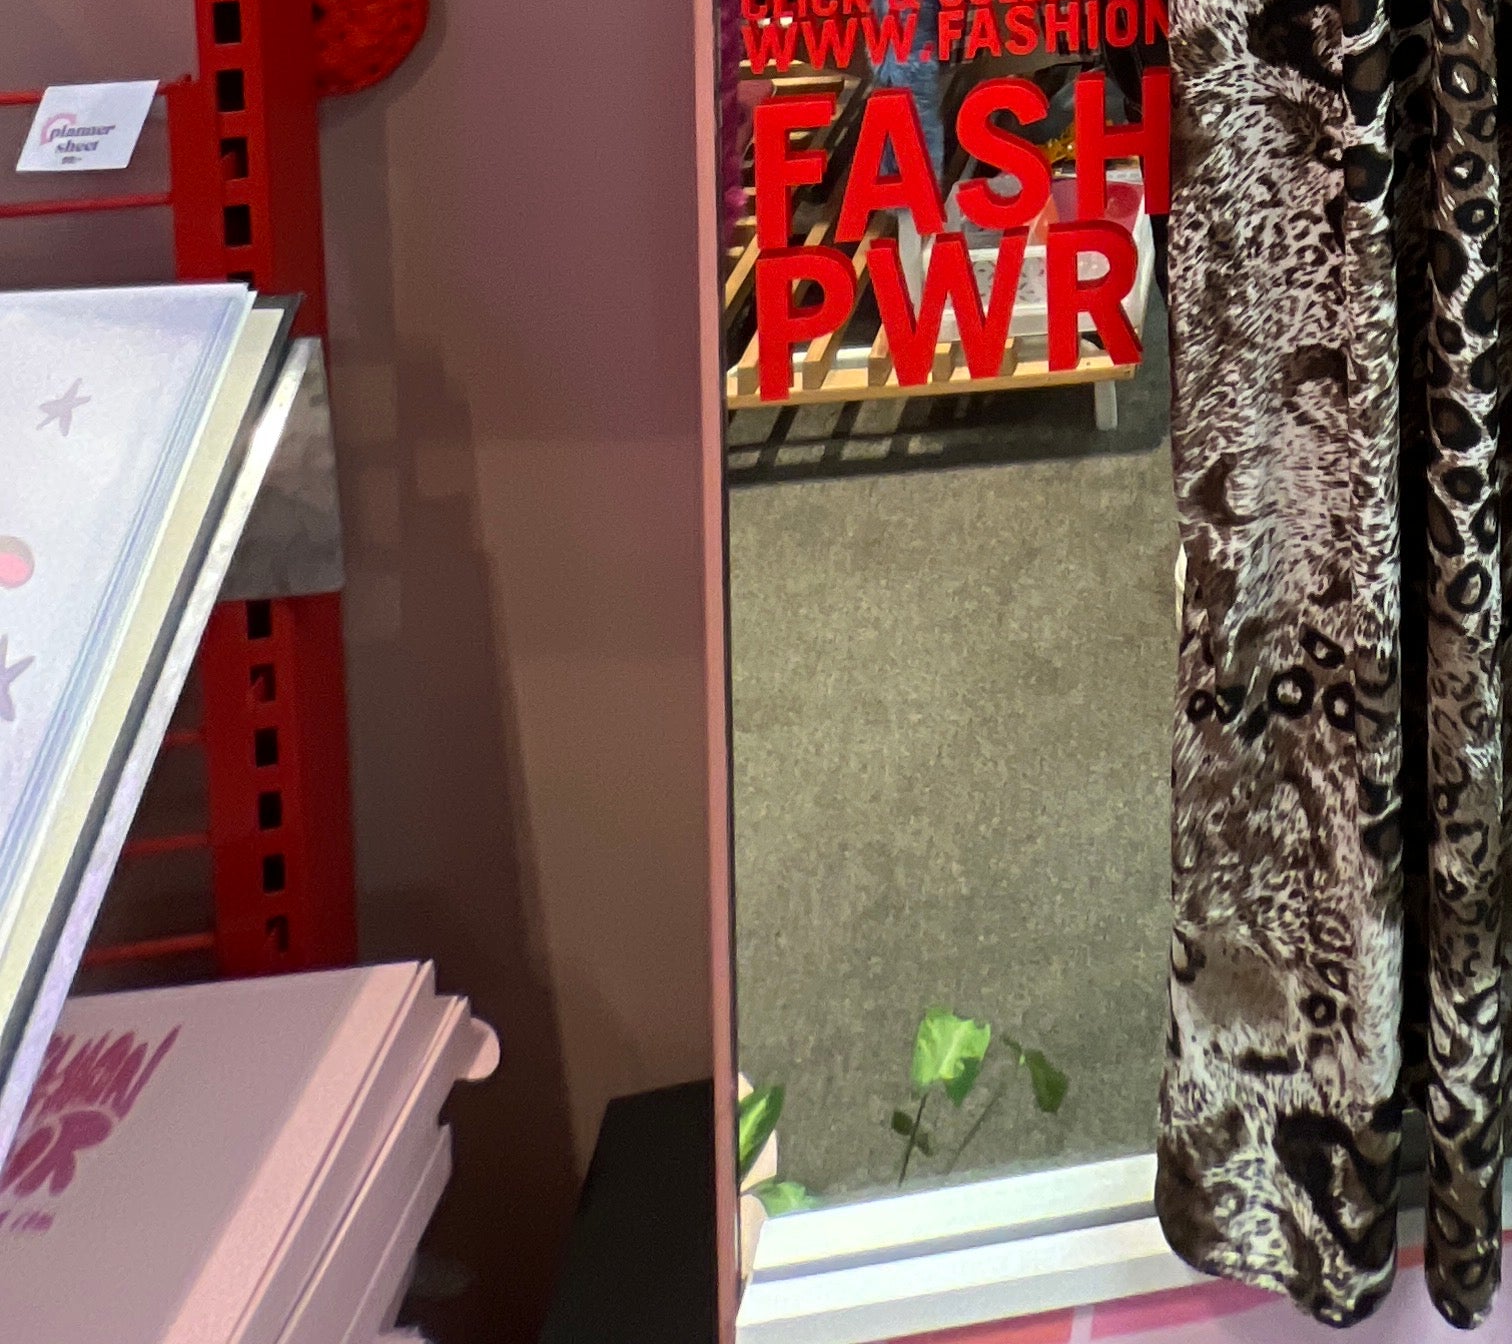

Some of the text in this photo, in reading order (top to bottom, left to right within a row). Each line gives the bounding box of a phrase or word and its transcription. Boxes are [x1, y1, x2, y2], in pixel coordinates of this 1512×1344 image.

[50, 124, 116, 142] planner
[55, 140, 99, 154] sheet
[752, 66, 1170, 252] FASH
[755, 218, 1143, 401] PWR
